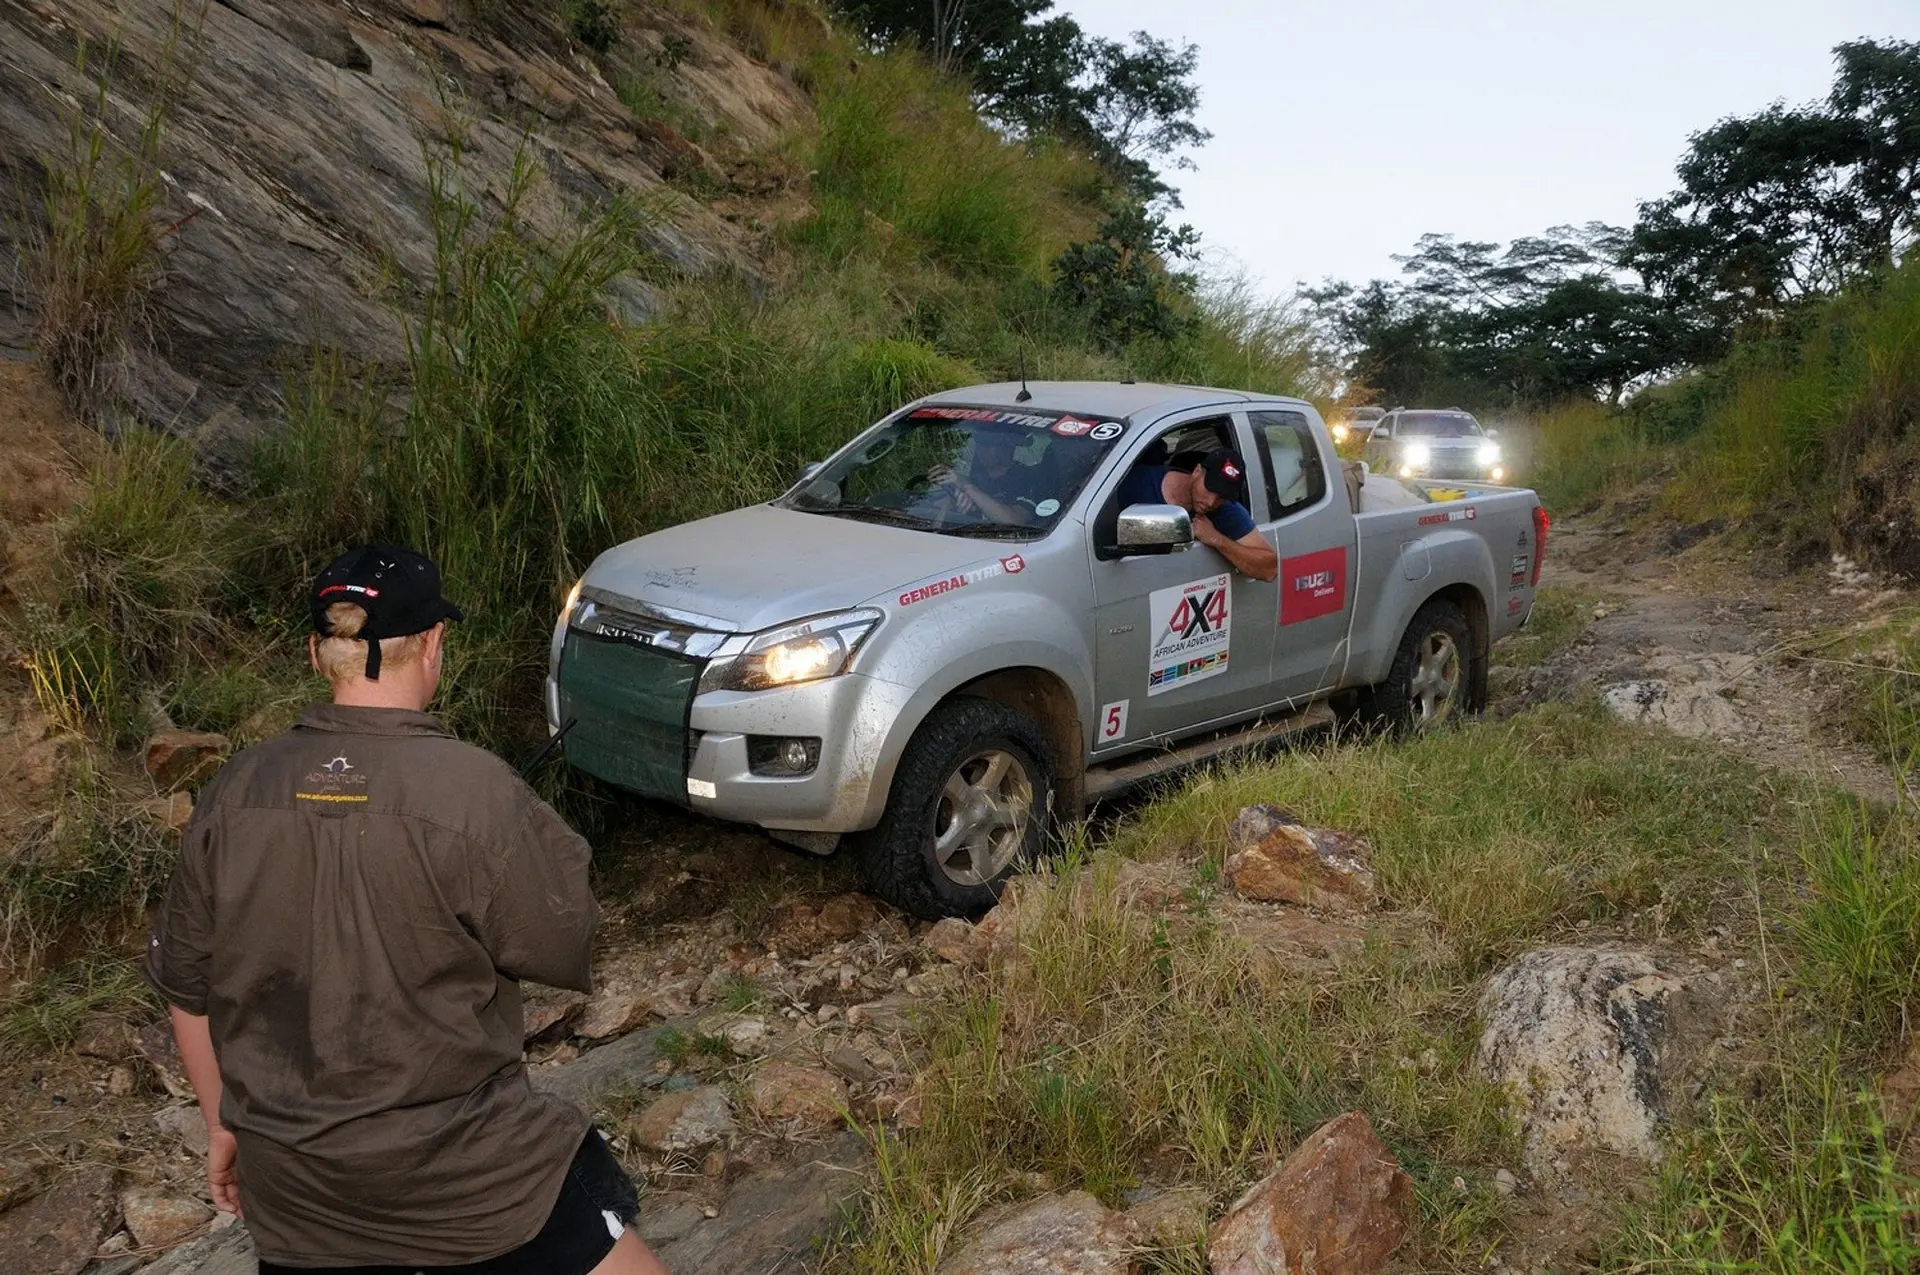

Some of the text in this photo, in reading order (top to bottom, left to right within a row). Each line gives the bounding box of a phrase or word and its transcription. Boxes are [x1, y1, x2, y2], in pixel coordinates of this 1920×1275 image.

[1168, 587, 1228, 640] 4X4
[1153, 629, 1228, 659] AFRICAN ADVENTURE
[1106, 706, 1121, 737] 5
